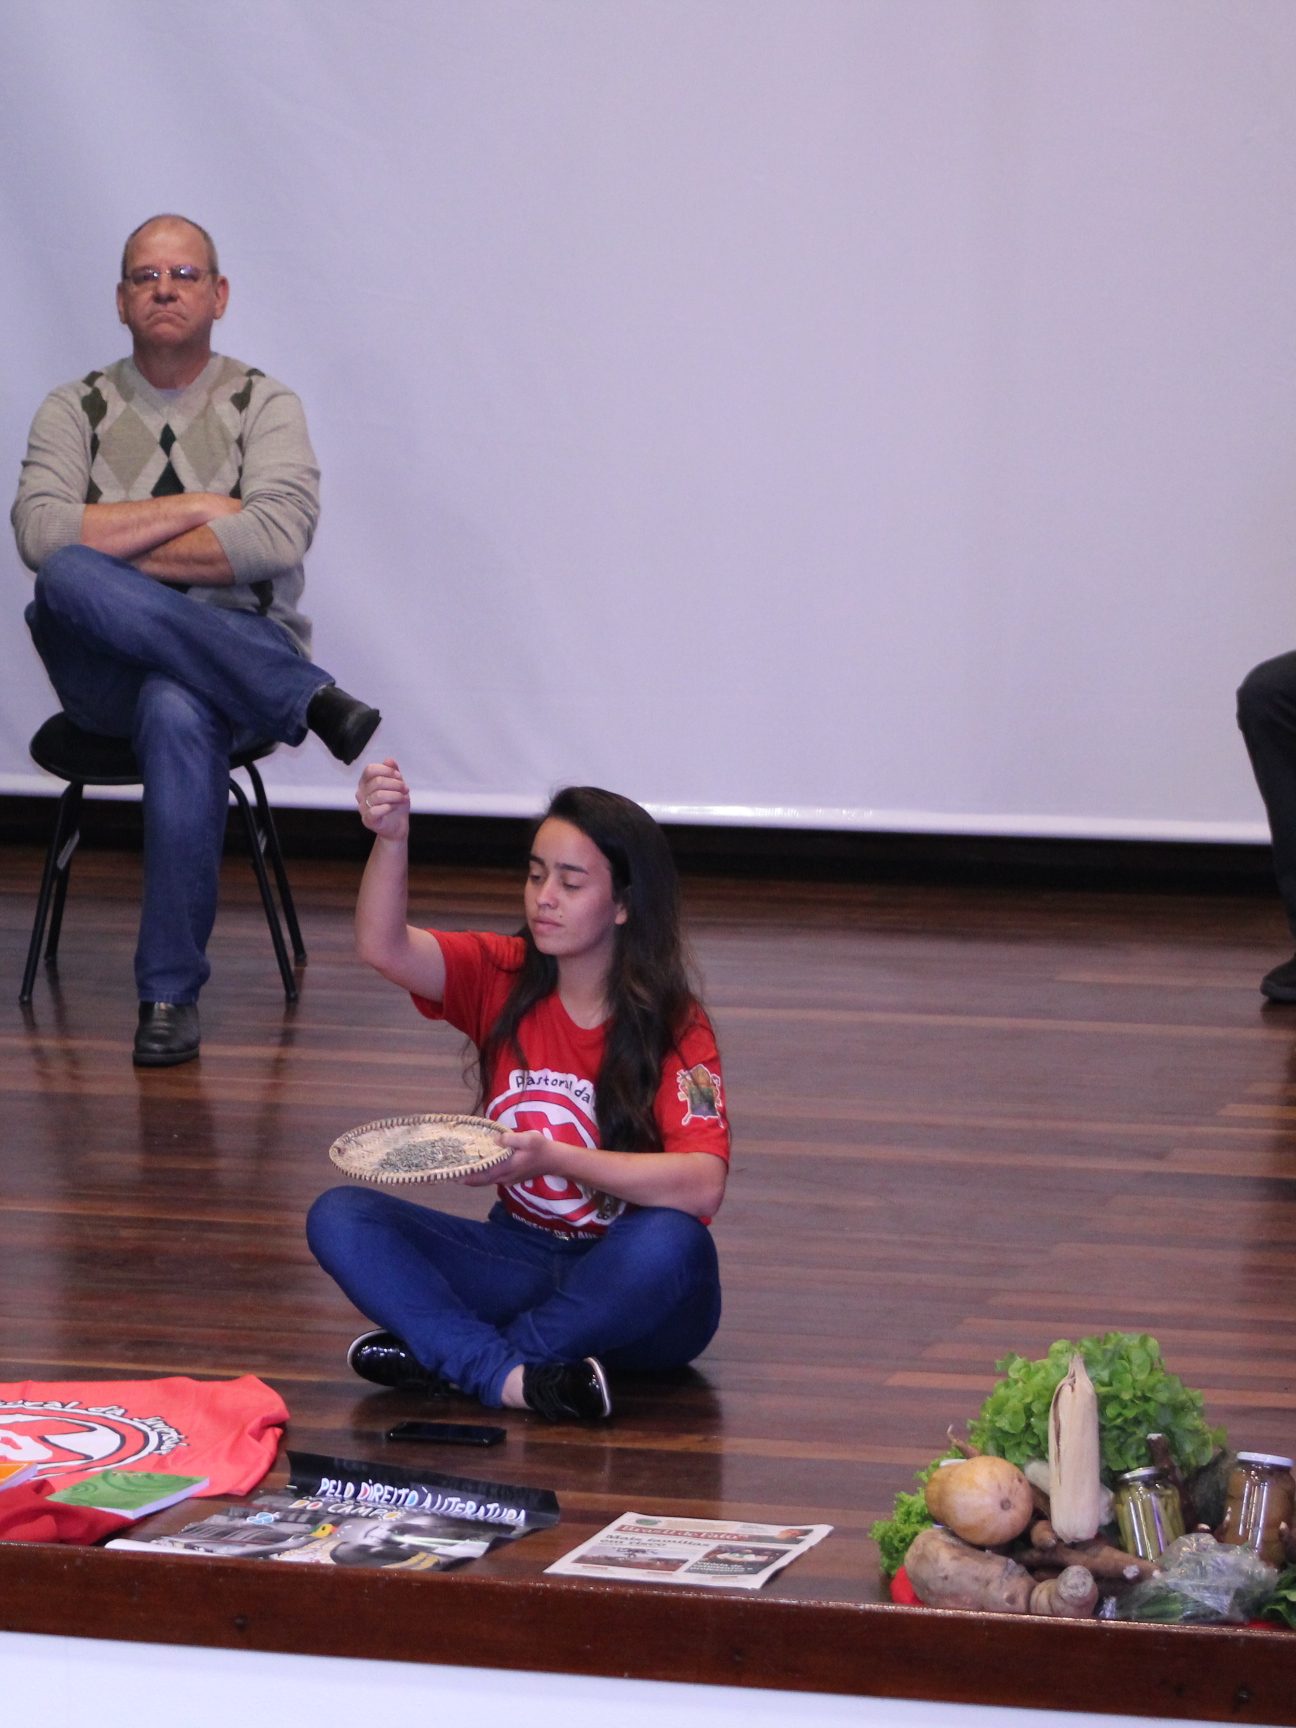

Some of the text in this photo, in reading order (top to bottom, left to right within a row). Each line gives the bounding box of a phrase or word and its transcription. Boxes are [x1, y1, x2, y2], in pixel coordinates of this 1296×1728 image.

[316, 1477, 355, 1499] PELO
[288, 1499, 404, 1521] DO CAMPO
[606, 1534, 643, 1542] Mais
